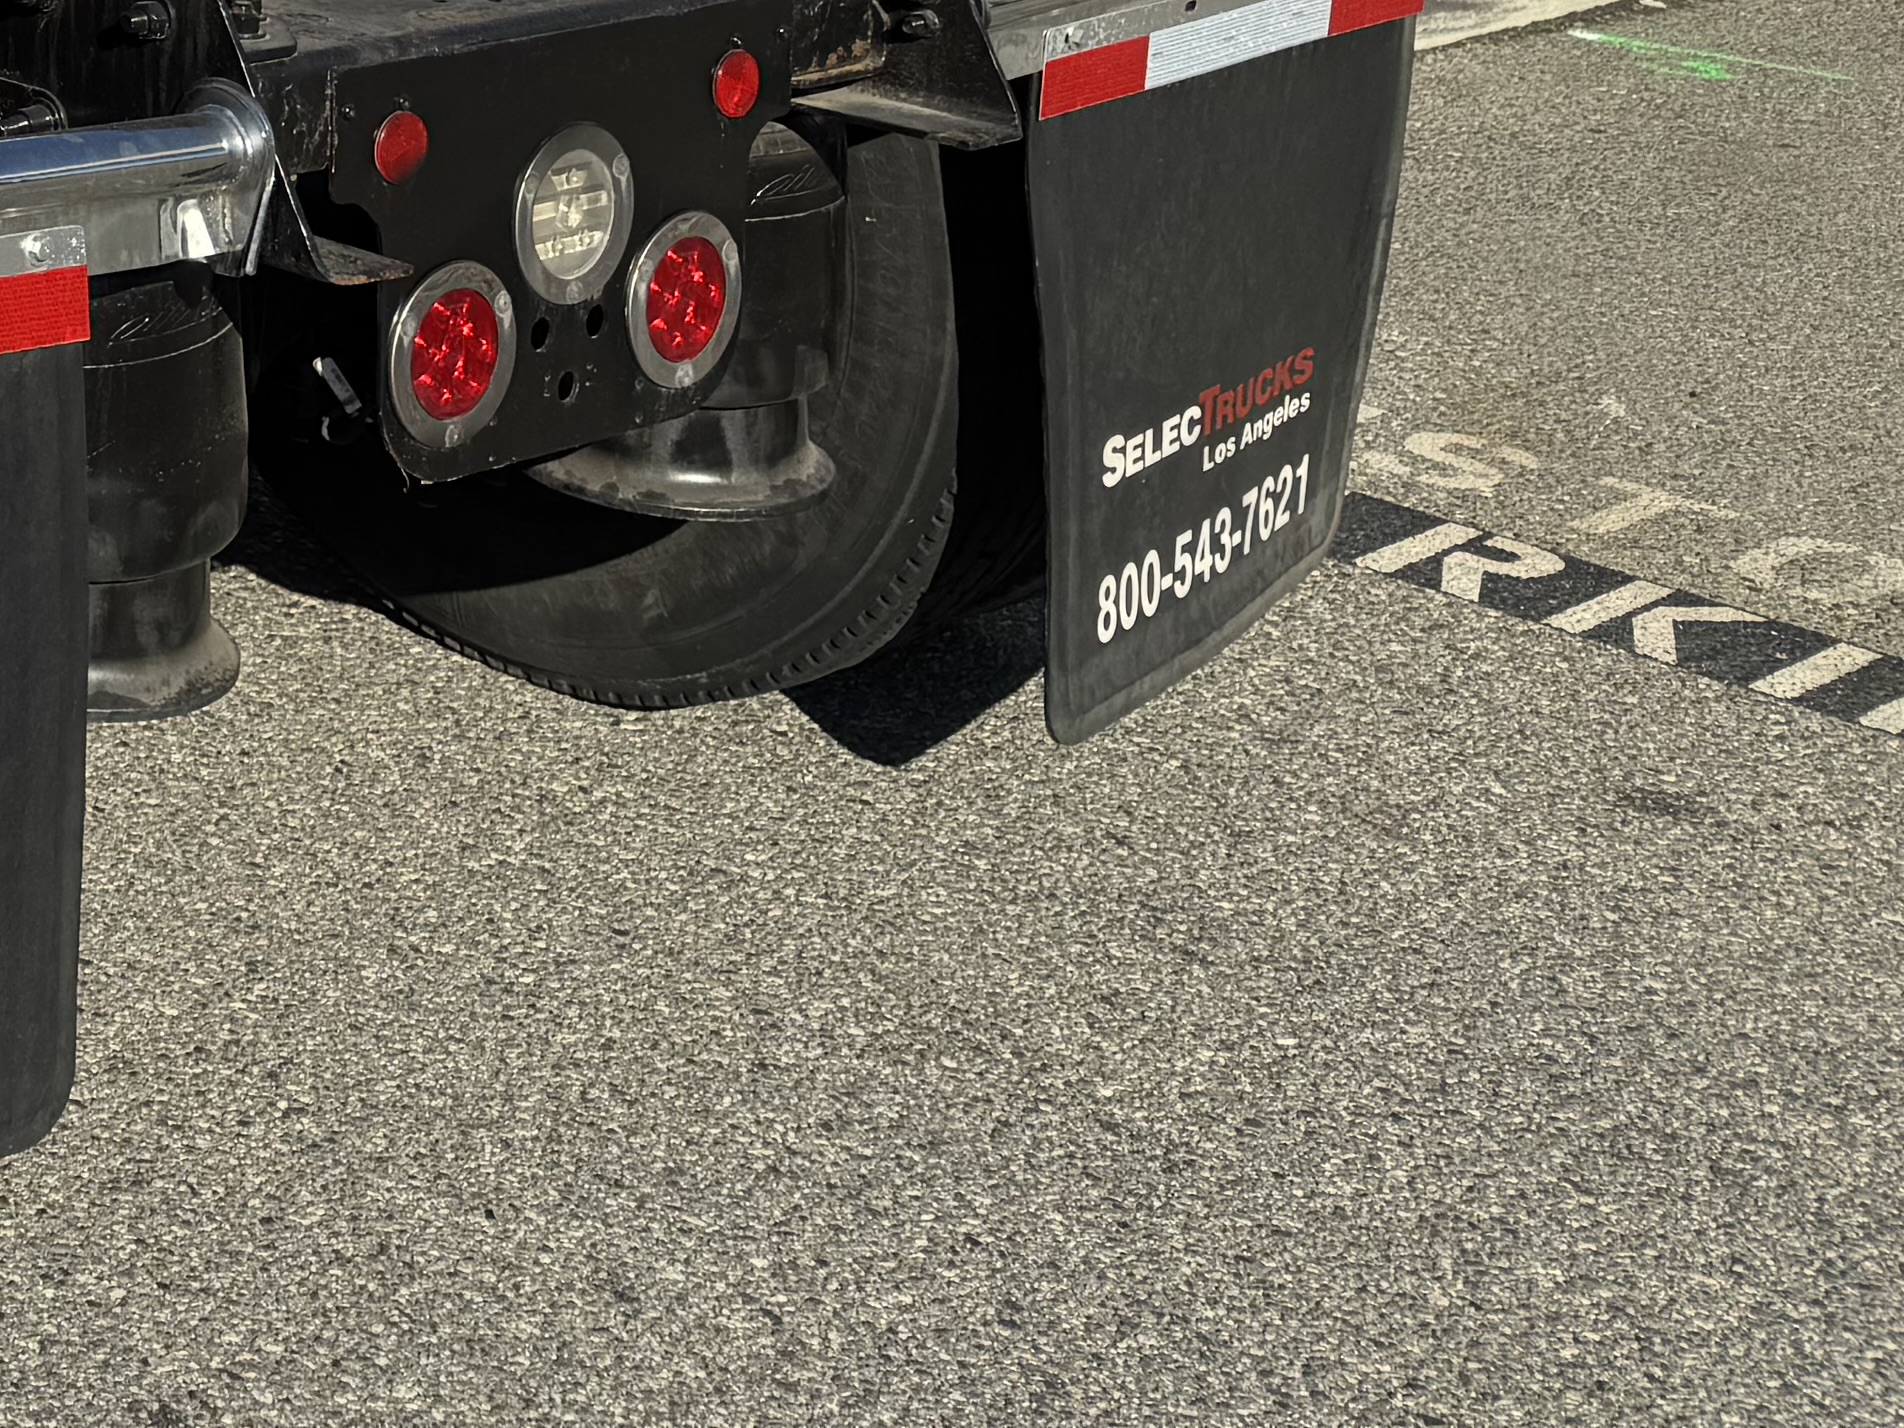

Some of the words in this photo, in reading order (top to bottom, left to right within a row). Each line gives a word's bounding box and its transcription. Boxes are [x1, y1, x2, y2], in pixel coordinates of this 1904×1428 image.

[1202, 435, 1236, 472] Los
[1239, 392, 1310, 450] Angeles
[1097, 453, 1310, 644] 800-543-7621
